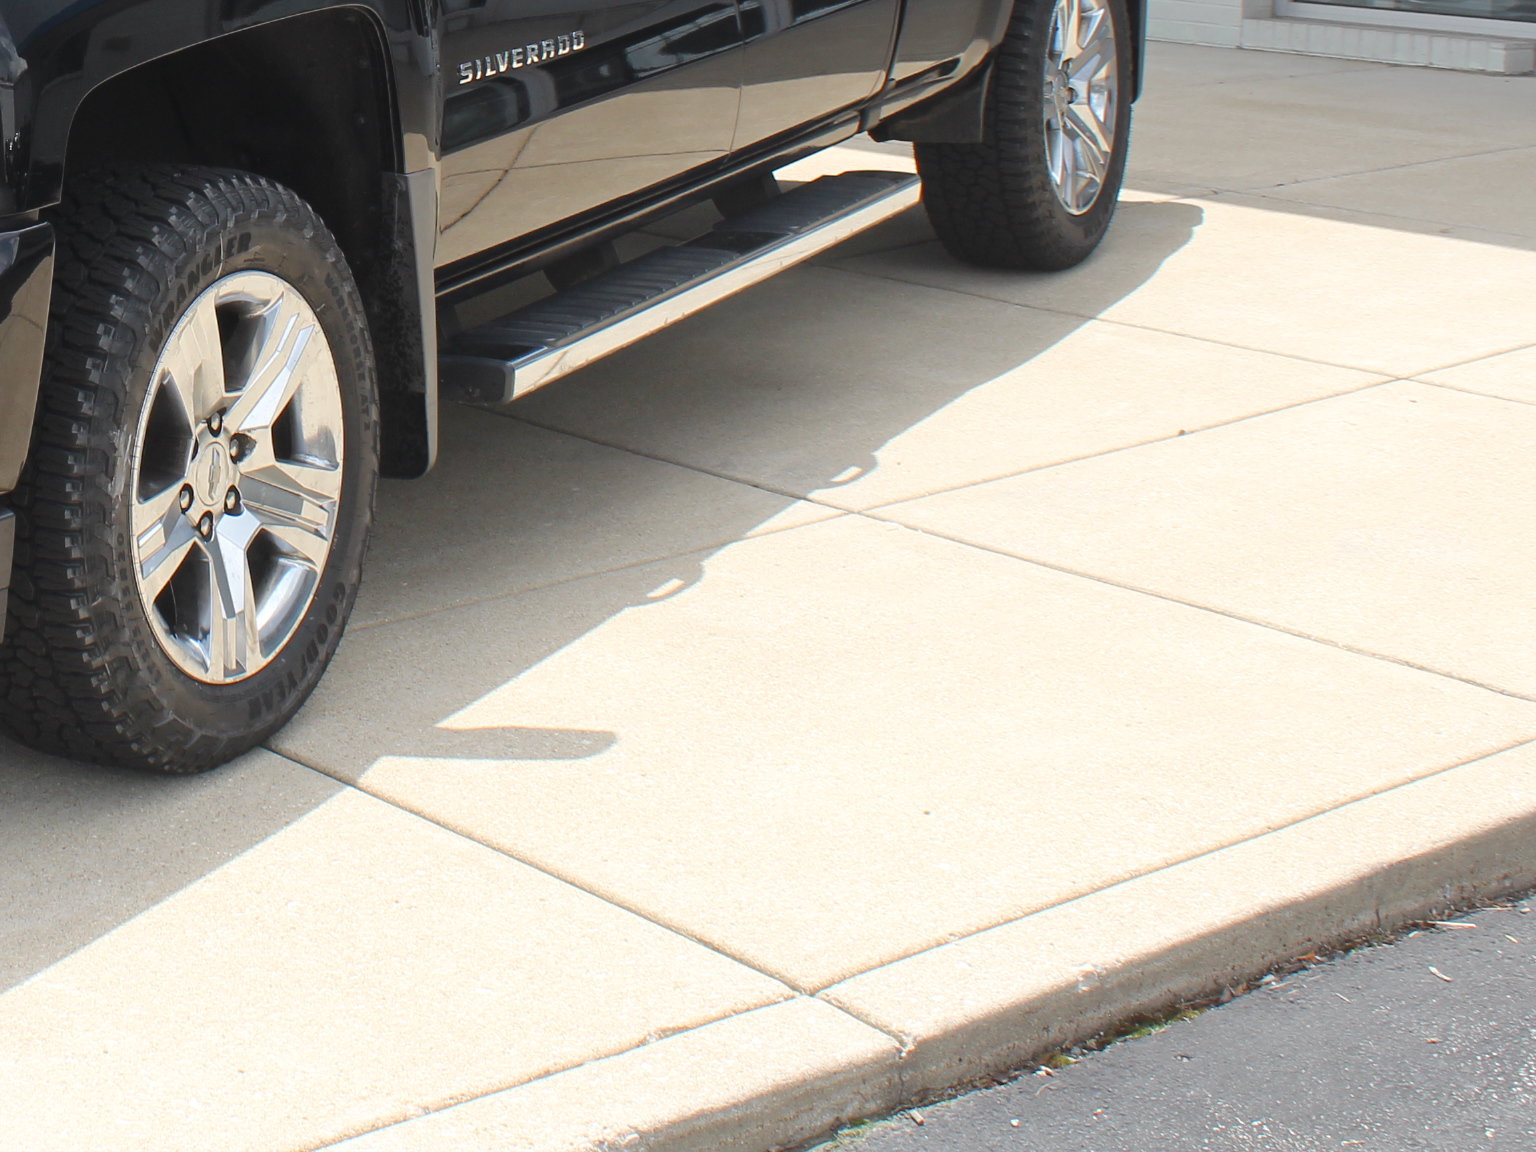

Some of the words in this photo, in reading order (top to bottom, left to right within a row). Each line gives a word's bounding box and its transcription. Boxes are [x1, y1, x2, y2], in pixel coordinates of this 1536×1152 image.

[458, 30, 586, 85] SILVERADO
[147, 231, 252, 353] WRANGLER
[247, 581, 346, 721] GOODYEAR
